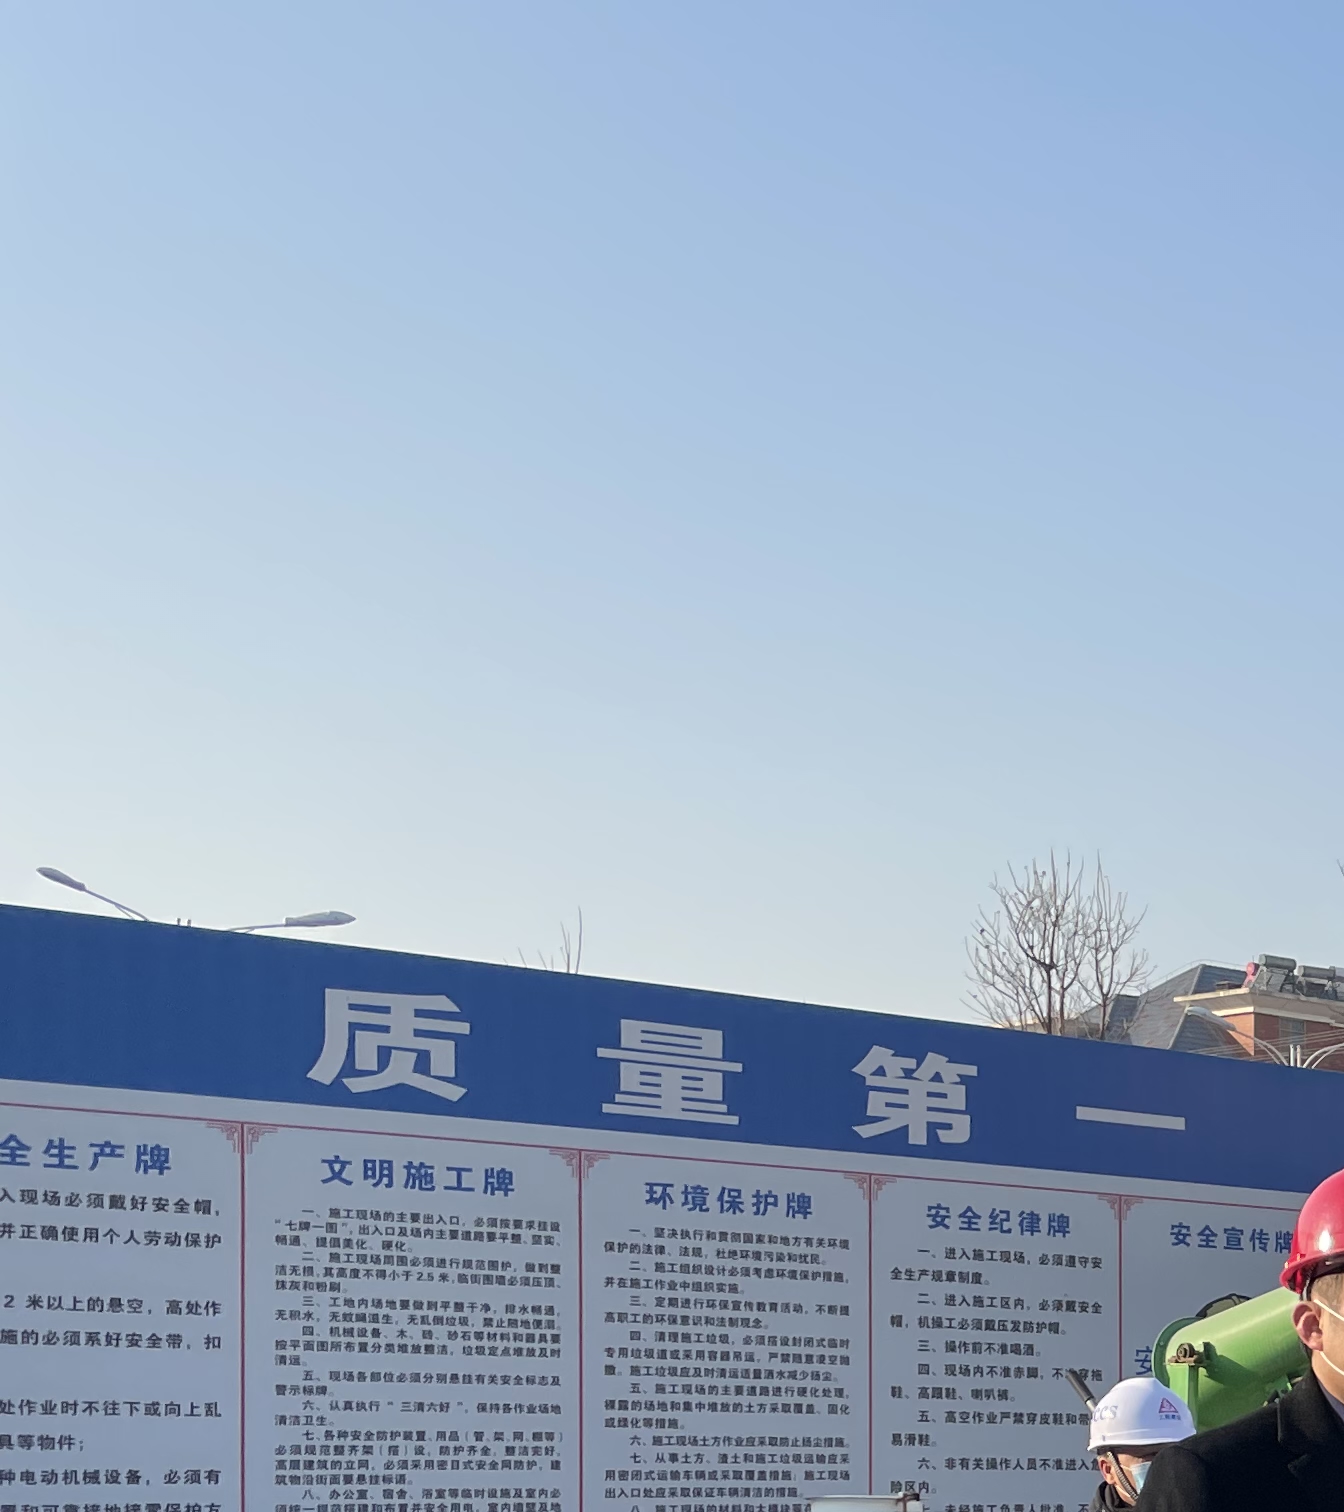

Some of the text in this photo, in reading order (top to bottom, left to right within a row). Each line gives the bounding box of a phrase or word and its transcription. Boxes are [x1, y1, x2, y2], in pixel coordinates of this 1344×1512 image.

[306, 986, 1187, 1147] 质量第一
[0, 1134, 171, 1176] 全生产牌
[321, 1155, 516, 1197] 文明施工牌
[644, 1182, 813, 1220] 环境保护牌
[926, 1203, 1071, 1238] 安全纪律牌
